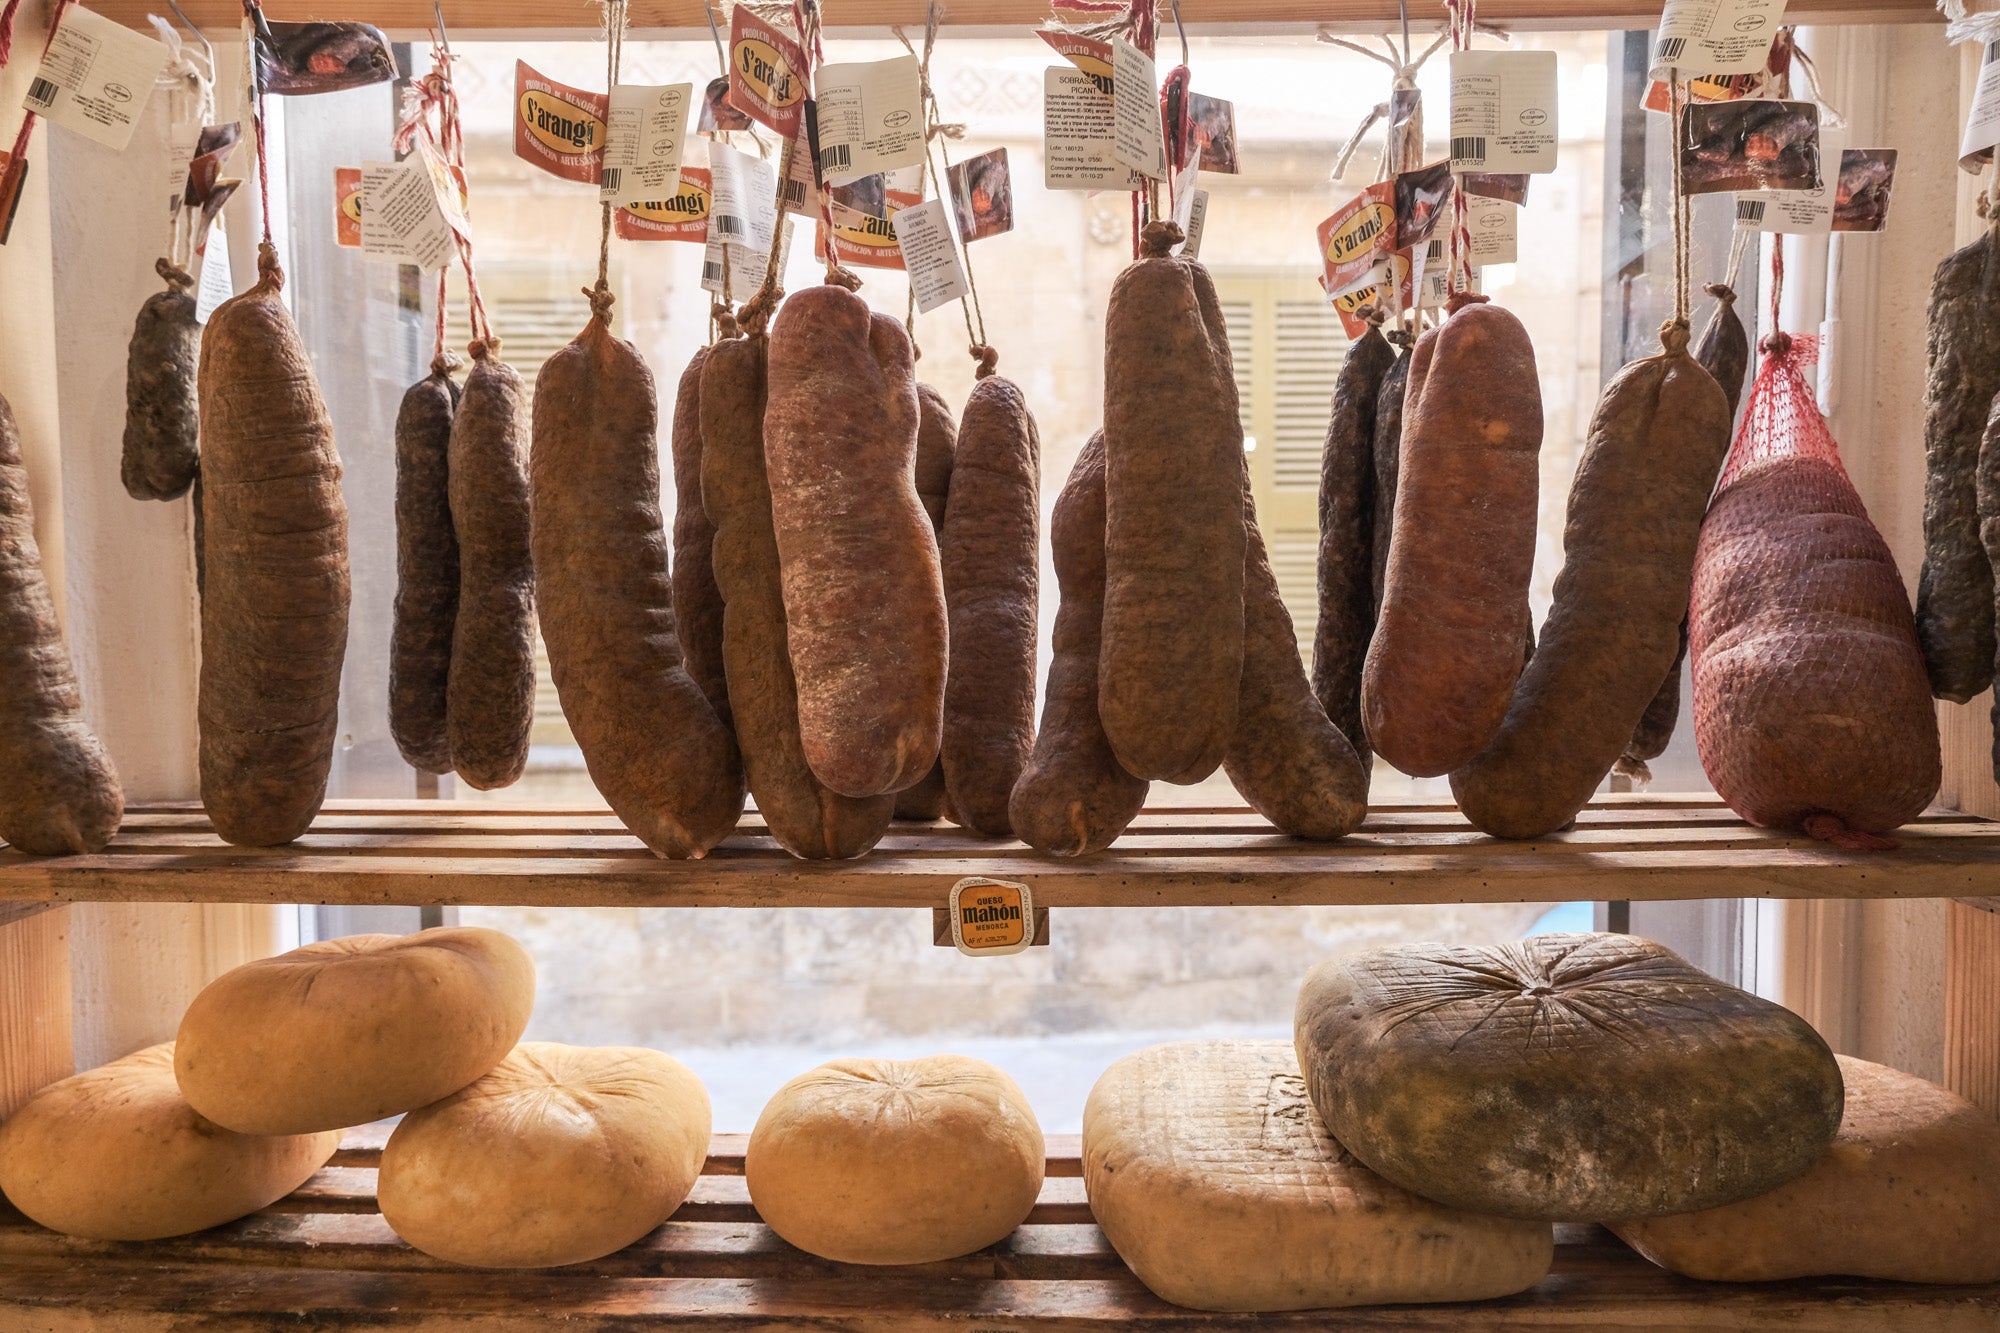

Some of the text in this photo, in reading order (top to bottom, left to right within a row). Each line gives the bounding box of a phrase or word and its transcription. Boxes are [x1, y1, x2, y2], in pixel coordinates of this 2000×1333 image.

[565, 92, 603, 118] MENORCA
[527, 97, 596, 149] S'arangí
[977, 896, 1003, 906] QUESO
[962, 903, 1020, 924] mahón
[975, 923, 1009, 931] MENORCA
